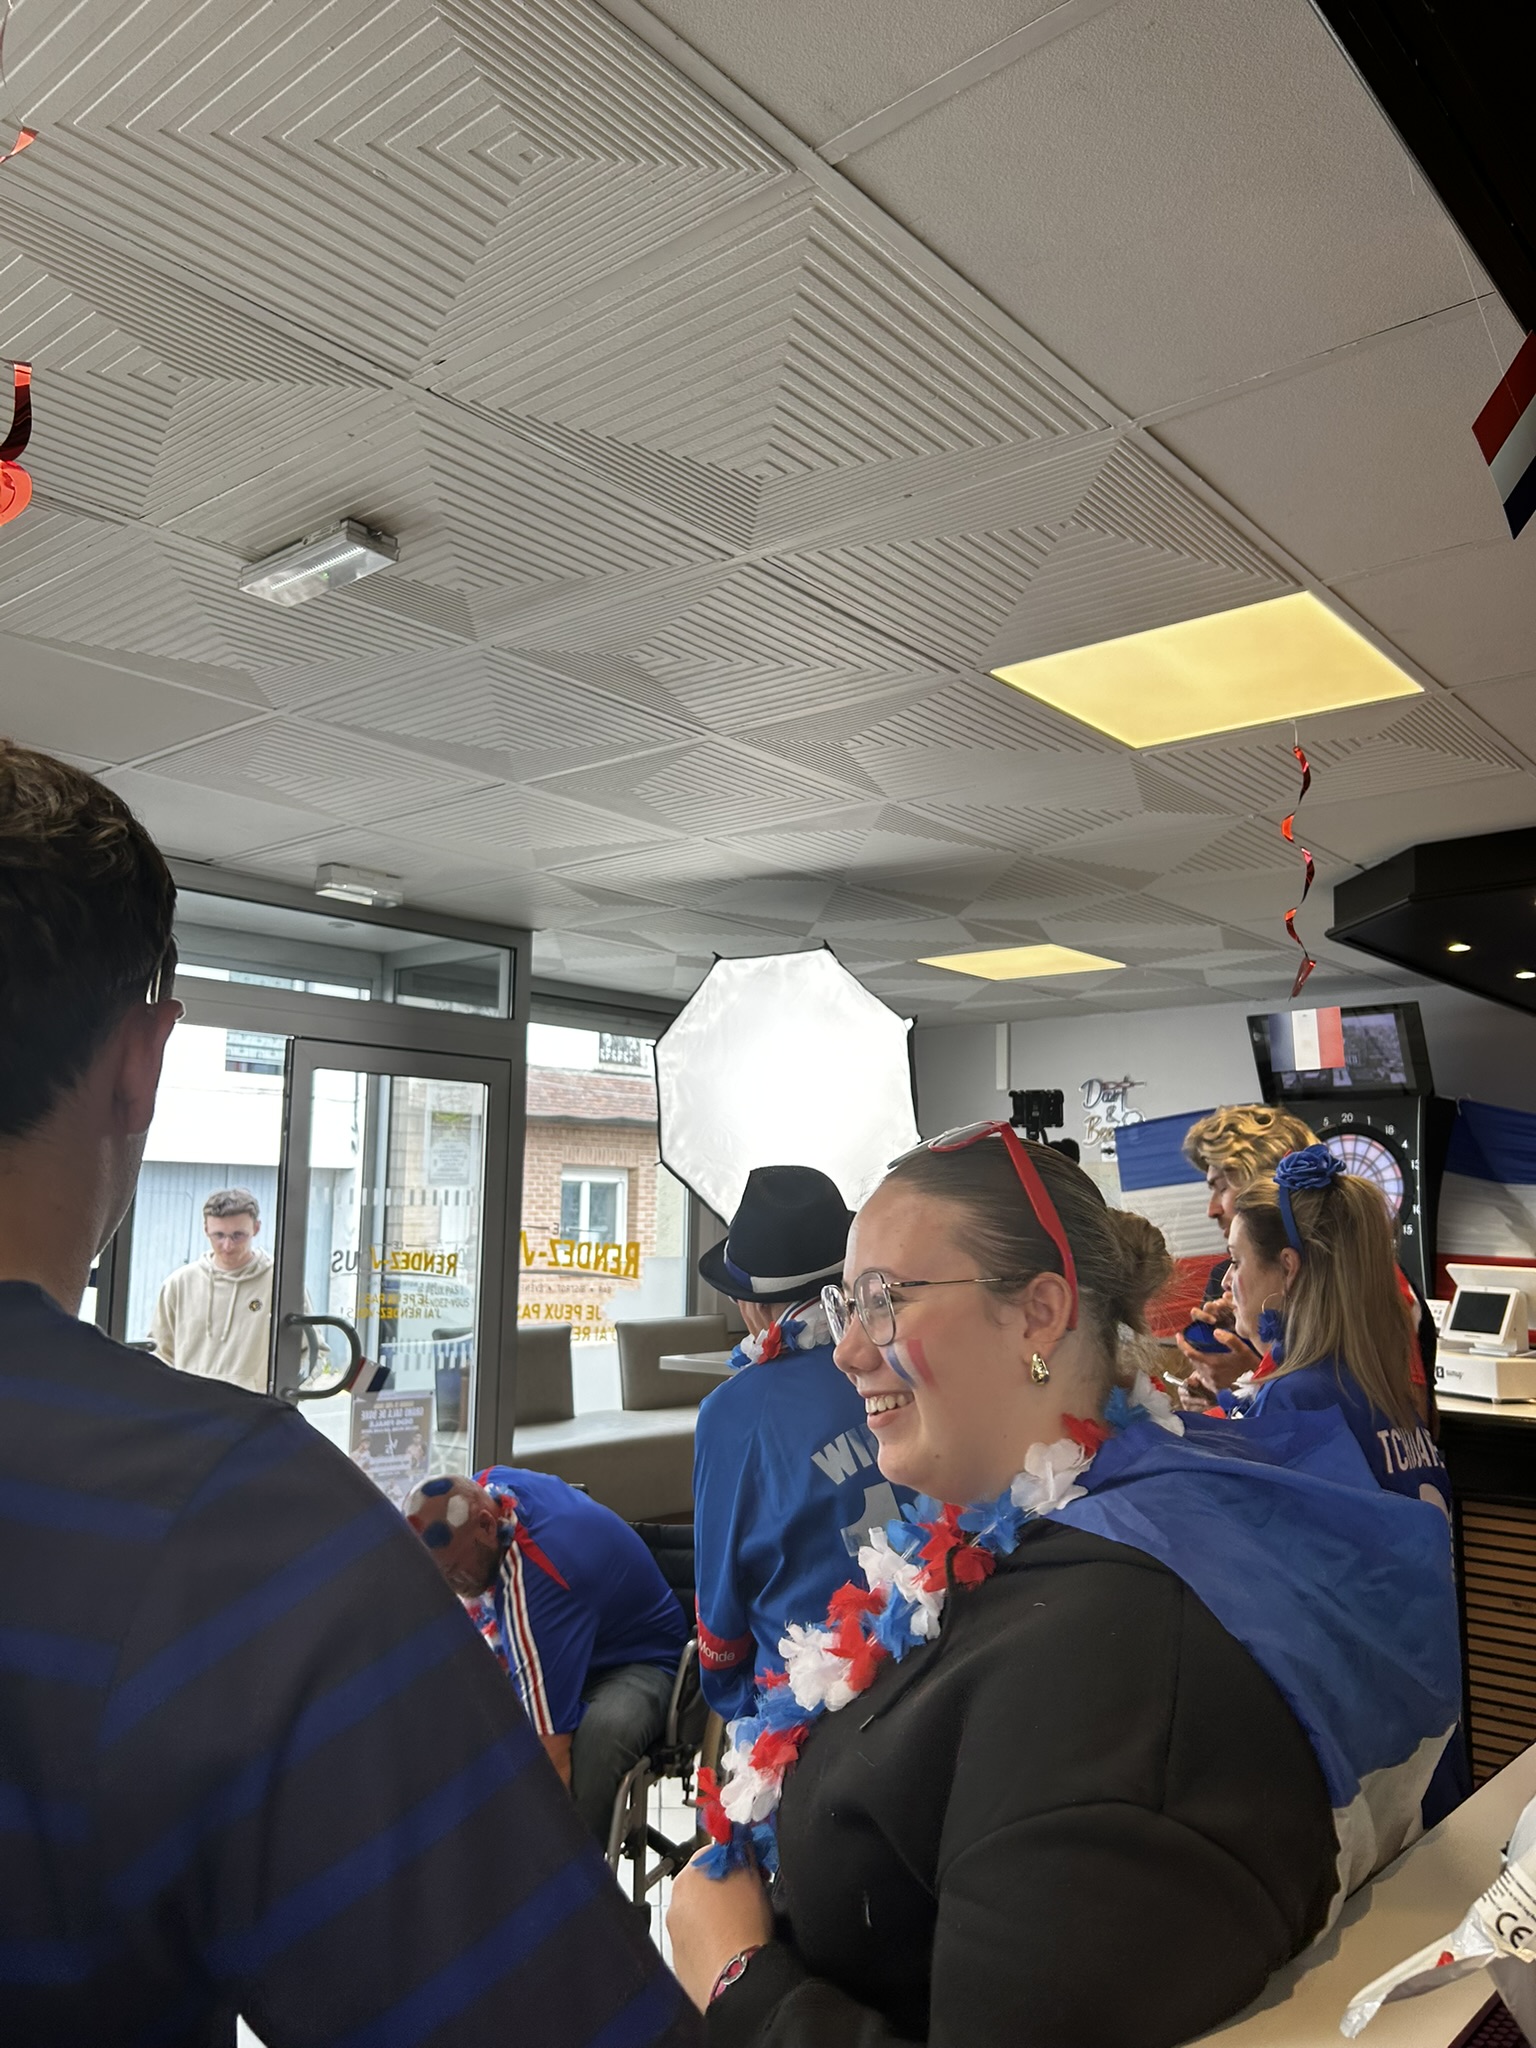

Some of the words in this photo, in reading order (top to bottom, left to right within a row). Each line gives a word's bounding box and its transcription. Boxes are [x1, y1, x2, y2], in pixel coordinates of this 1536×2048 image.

[1080, 1077, 1129, 1112] Dart
[1323, 1116, 1329, 1127] 5
[1341, 1112, 1354, 1123] 20
[1385, 1125, 1395, 1136] 18
[1401, 1139, 1408, 1149] 4
[1403, 1224, 1413, 1236] 15
[698, 1635, 735, 1662] Monde
[1495, 1911, 1533, 1949] CE
